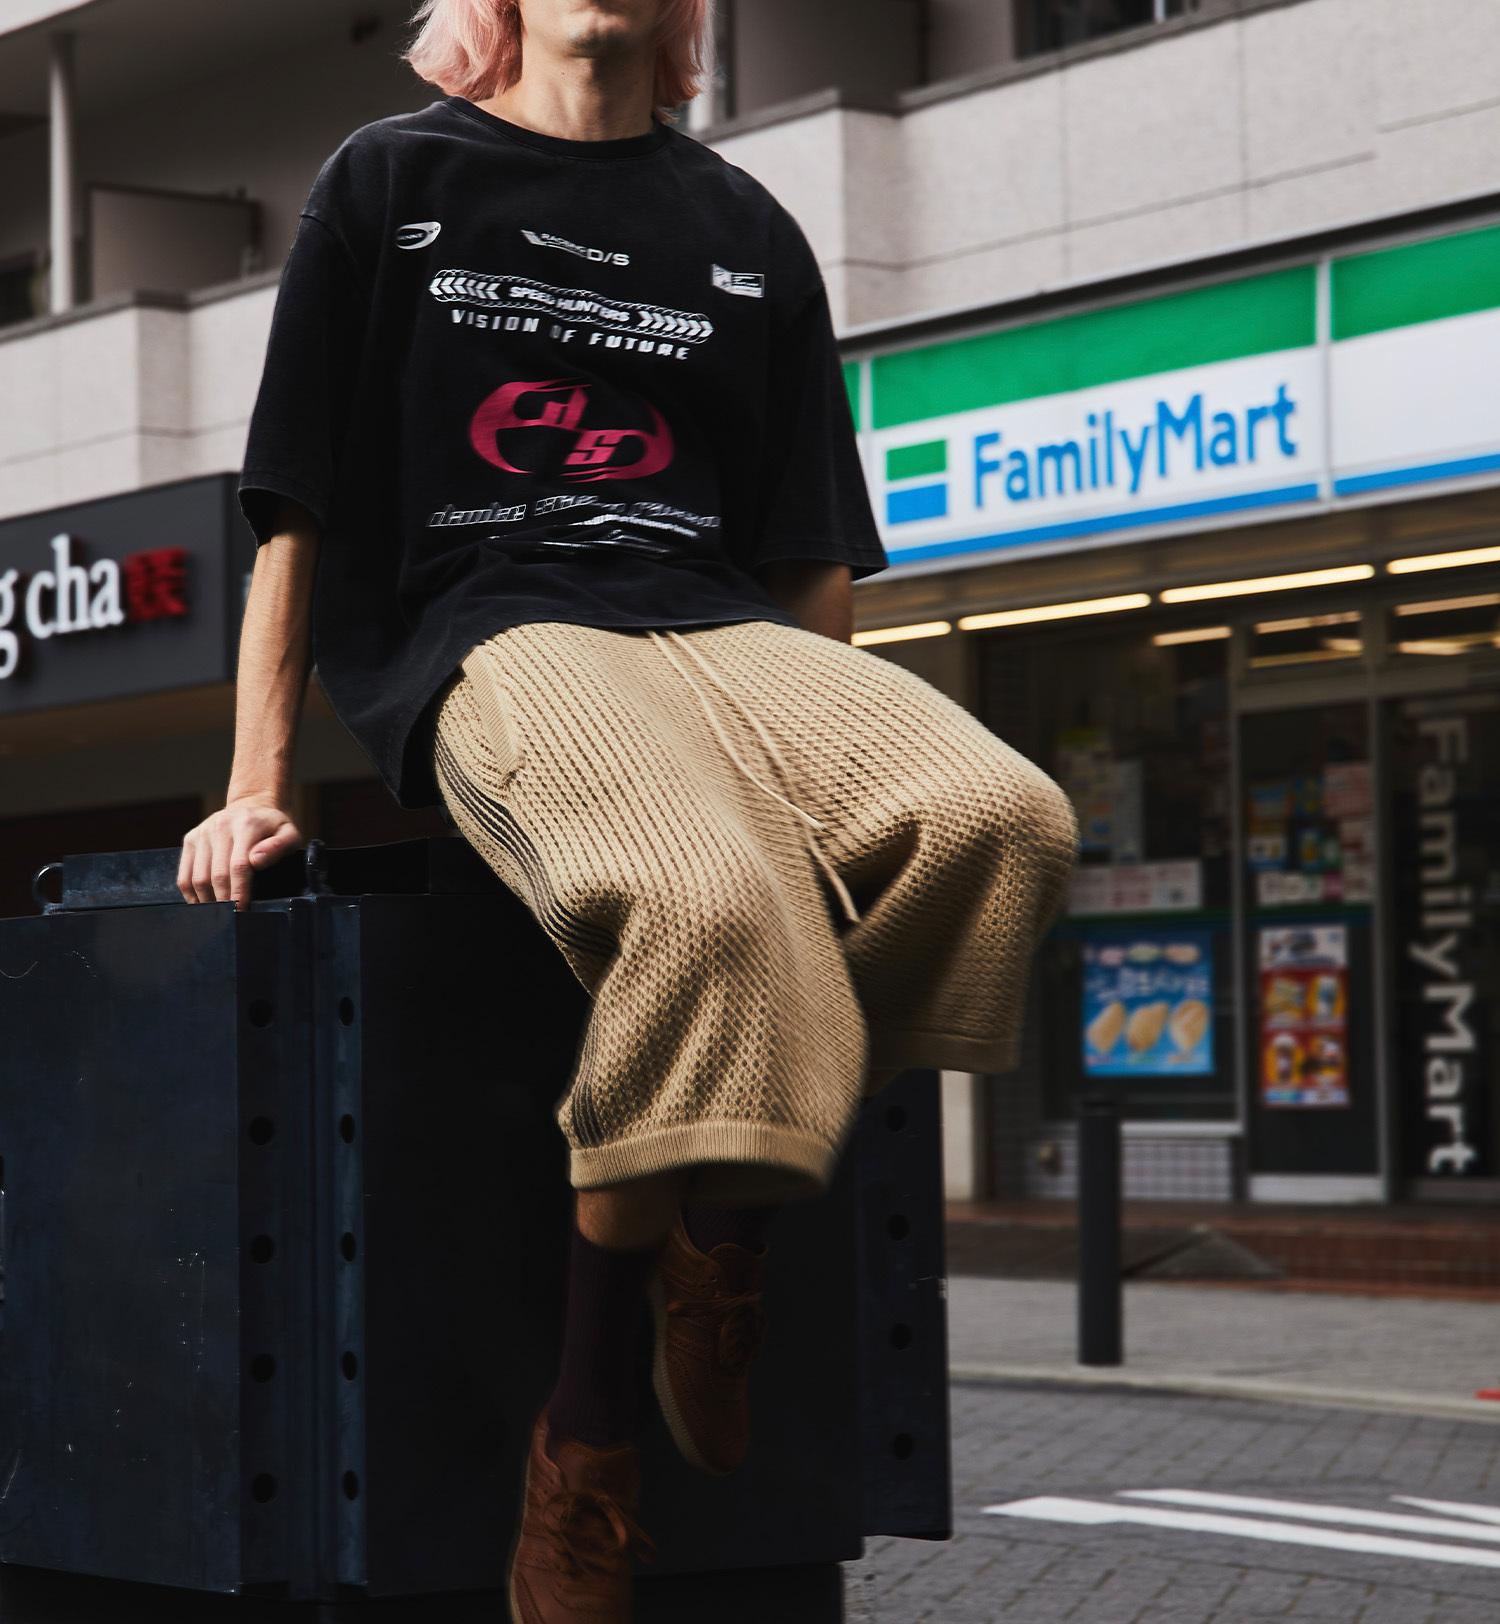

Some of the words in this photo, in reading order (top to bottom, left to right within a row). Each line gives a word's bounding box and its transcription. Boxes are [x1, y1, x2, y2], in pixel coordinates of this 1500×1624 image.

[586, 248, 631, 267] D/S
[451, 309, 540, 333] VISION
[588, 332, 691, 361] FUTURE
[973, 383, 1299, 509] FamilyMart
[25, 533, 125, 640] cha
[1408, 716, 1478, 1177] FamilyMart
